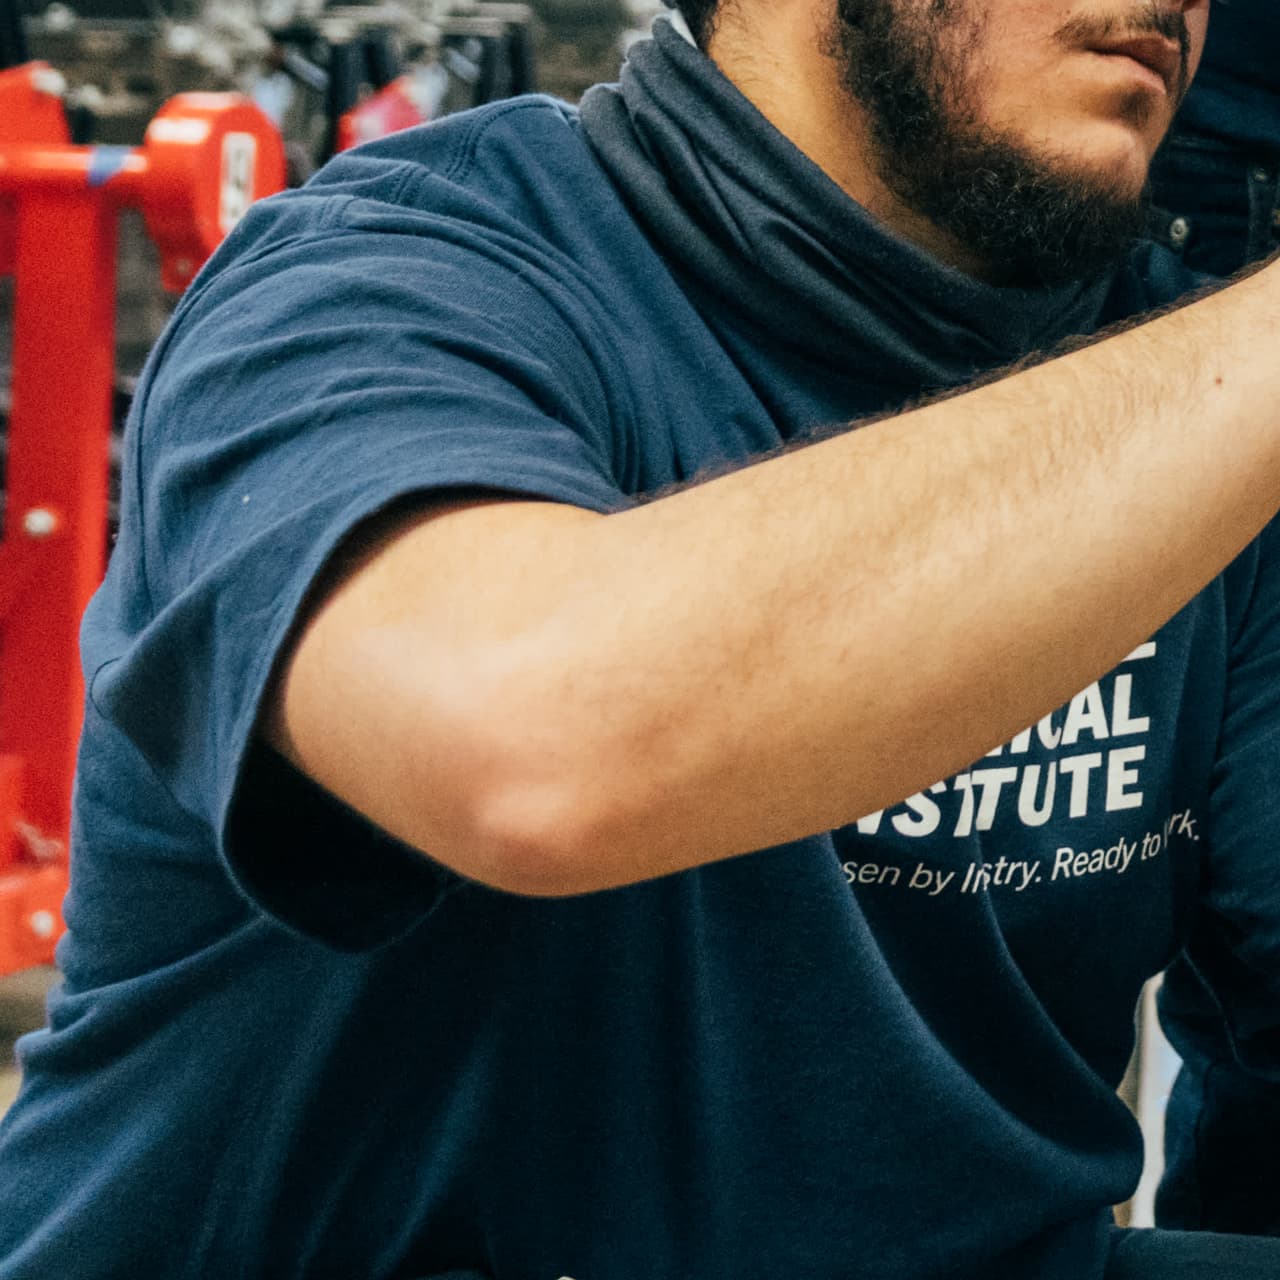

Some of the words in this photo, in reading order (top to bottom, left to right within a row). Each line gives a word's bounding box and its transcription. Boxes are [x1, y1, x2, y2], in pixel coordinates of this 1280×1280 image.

[908, 862, 955, 896] by
[1051, 836, 1138, 881] Ready
[1141, 831, 1161, 860] to
